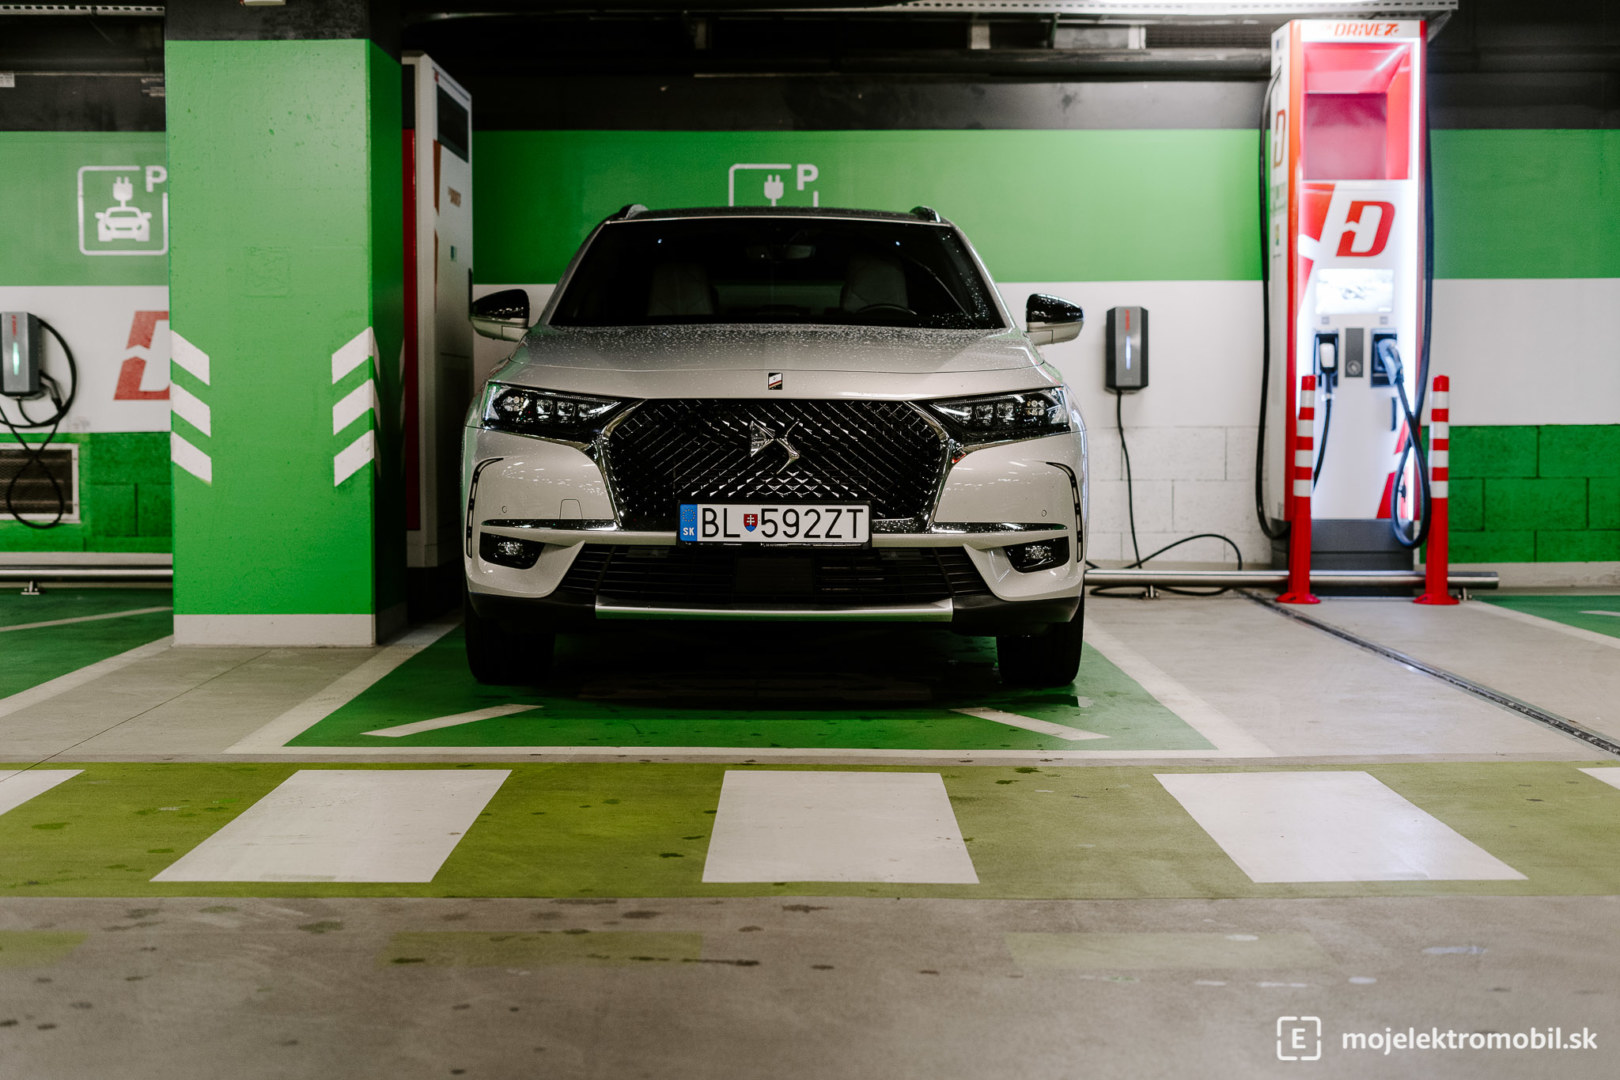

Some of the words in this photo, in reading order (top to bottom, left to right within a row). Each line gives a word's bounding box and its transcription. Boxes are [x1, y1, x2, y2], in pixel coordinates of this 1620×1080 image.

[145, 165, 168, 193] P
[797, 163, 819, 191] P
[1335, 200, 1396, 257] D
[682, 526, 695, 537] SK
[701, 507, 741, 539] BL
[760, 508, 865, 540] 592ZT
